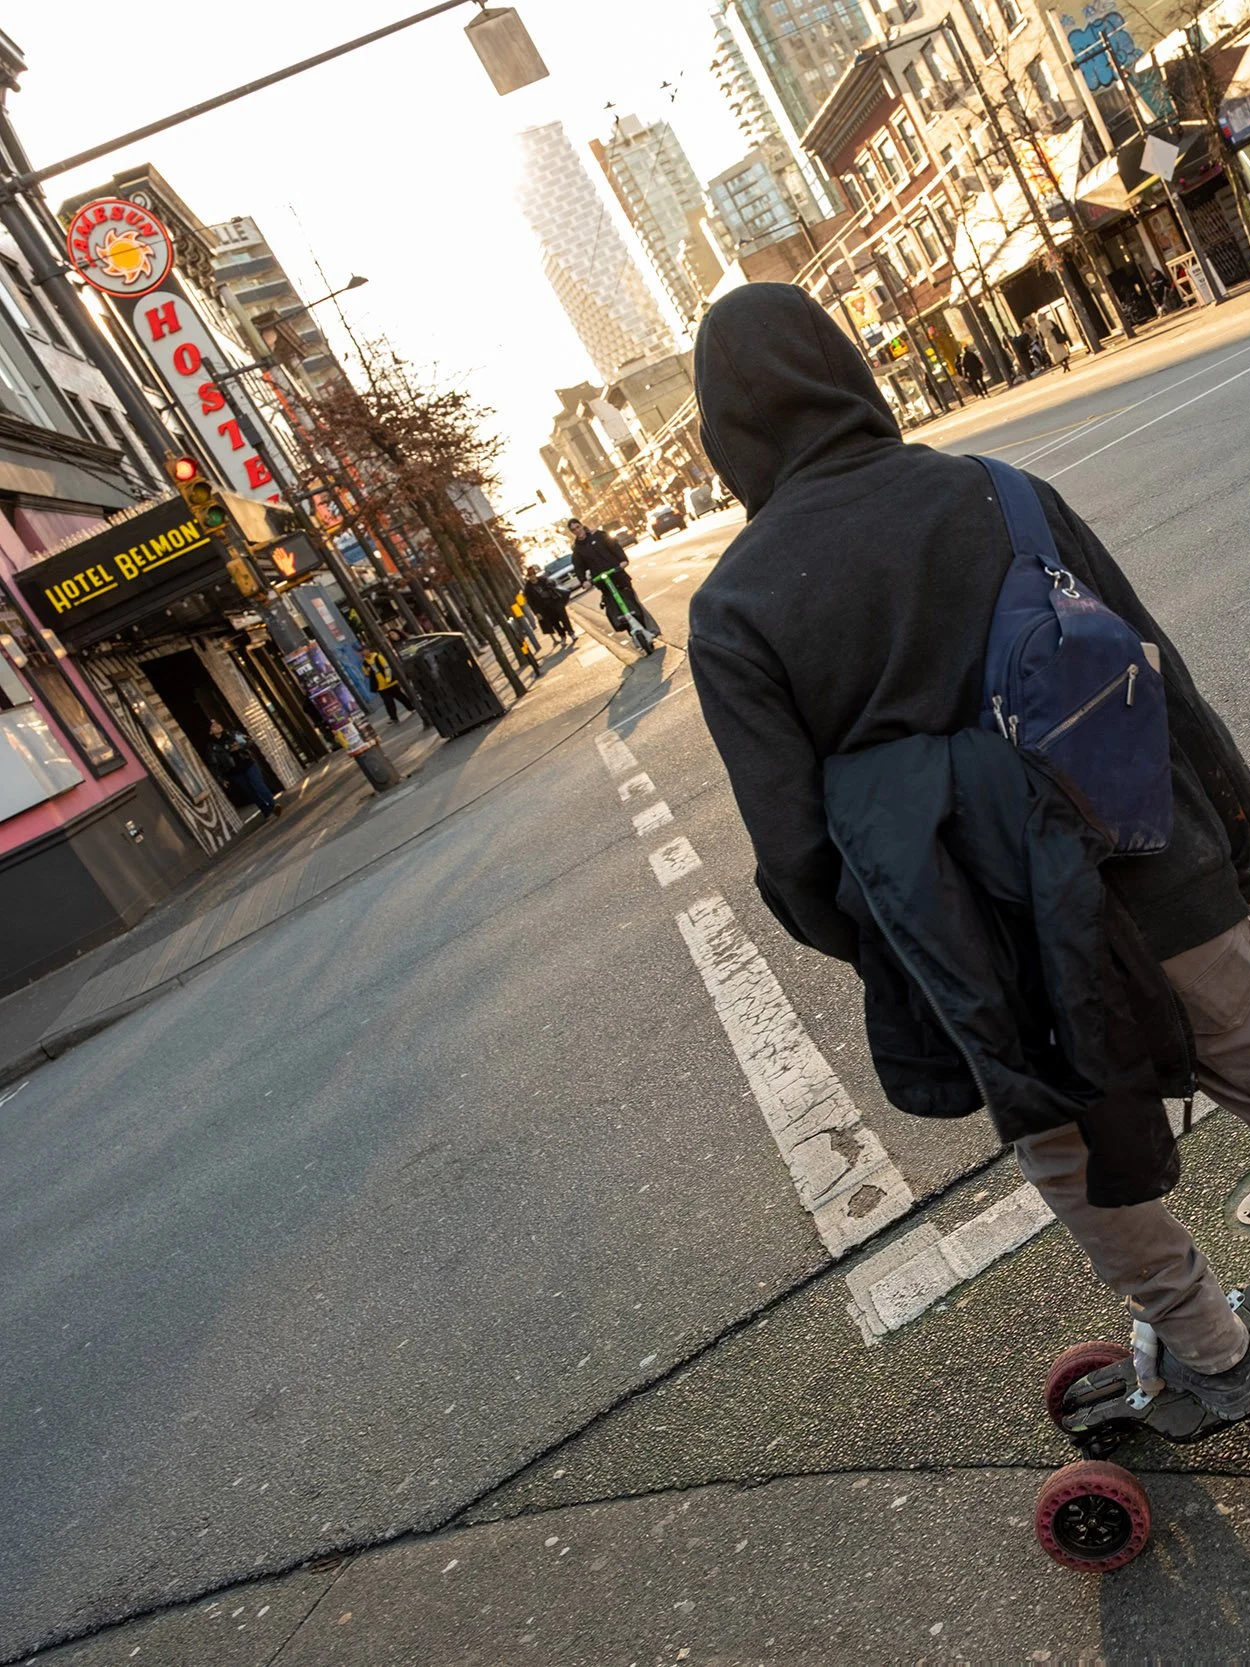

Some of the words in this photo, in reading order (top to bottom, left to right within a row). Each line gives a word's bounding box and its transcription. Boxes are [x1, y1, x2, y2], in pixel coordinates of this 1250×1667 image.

[145, 300, 280, 504] HOSTE
[45, 564, 115, 614] HOTEL
[114, 518, 200, 581] BELMON
